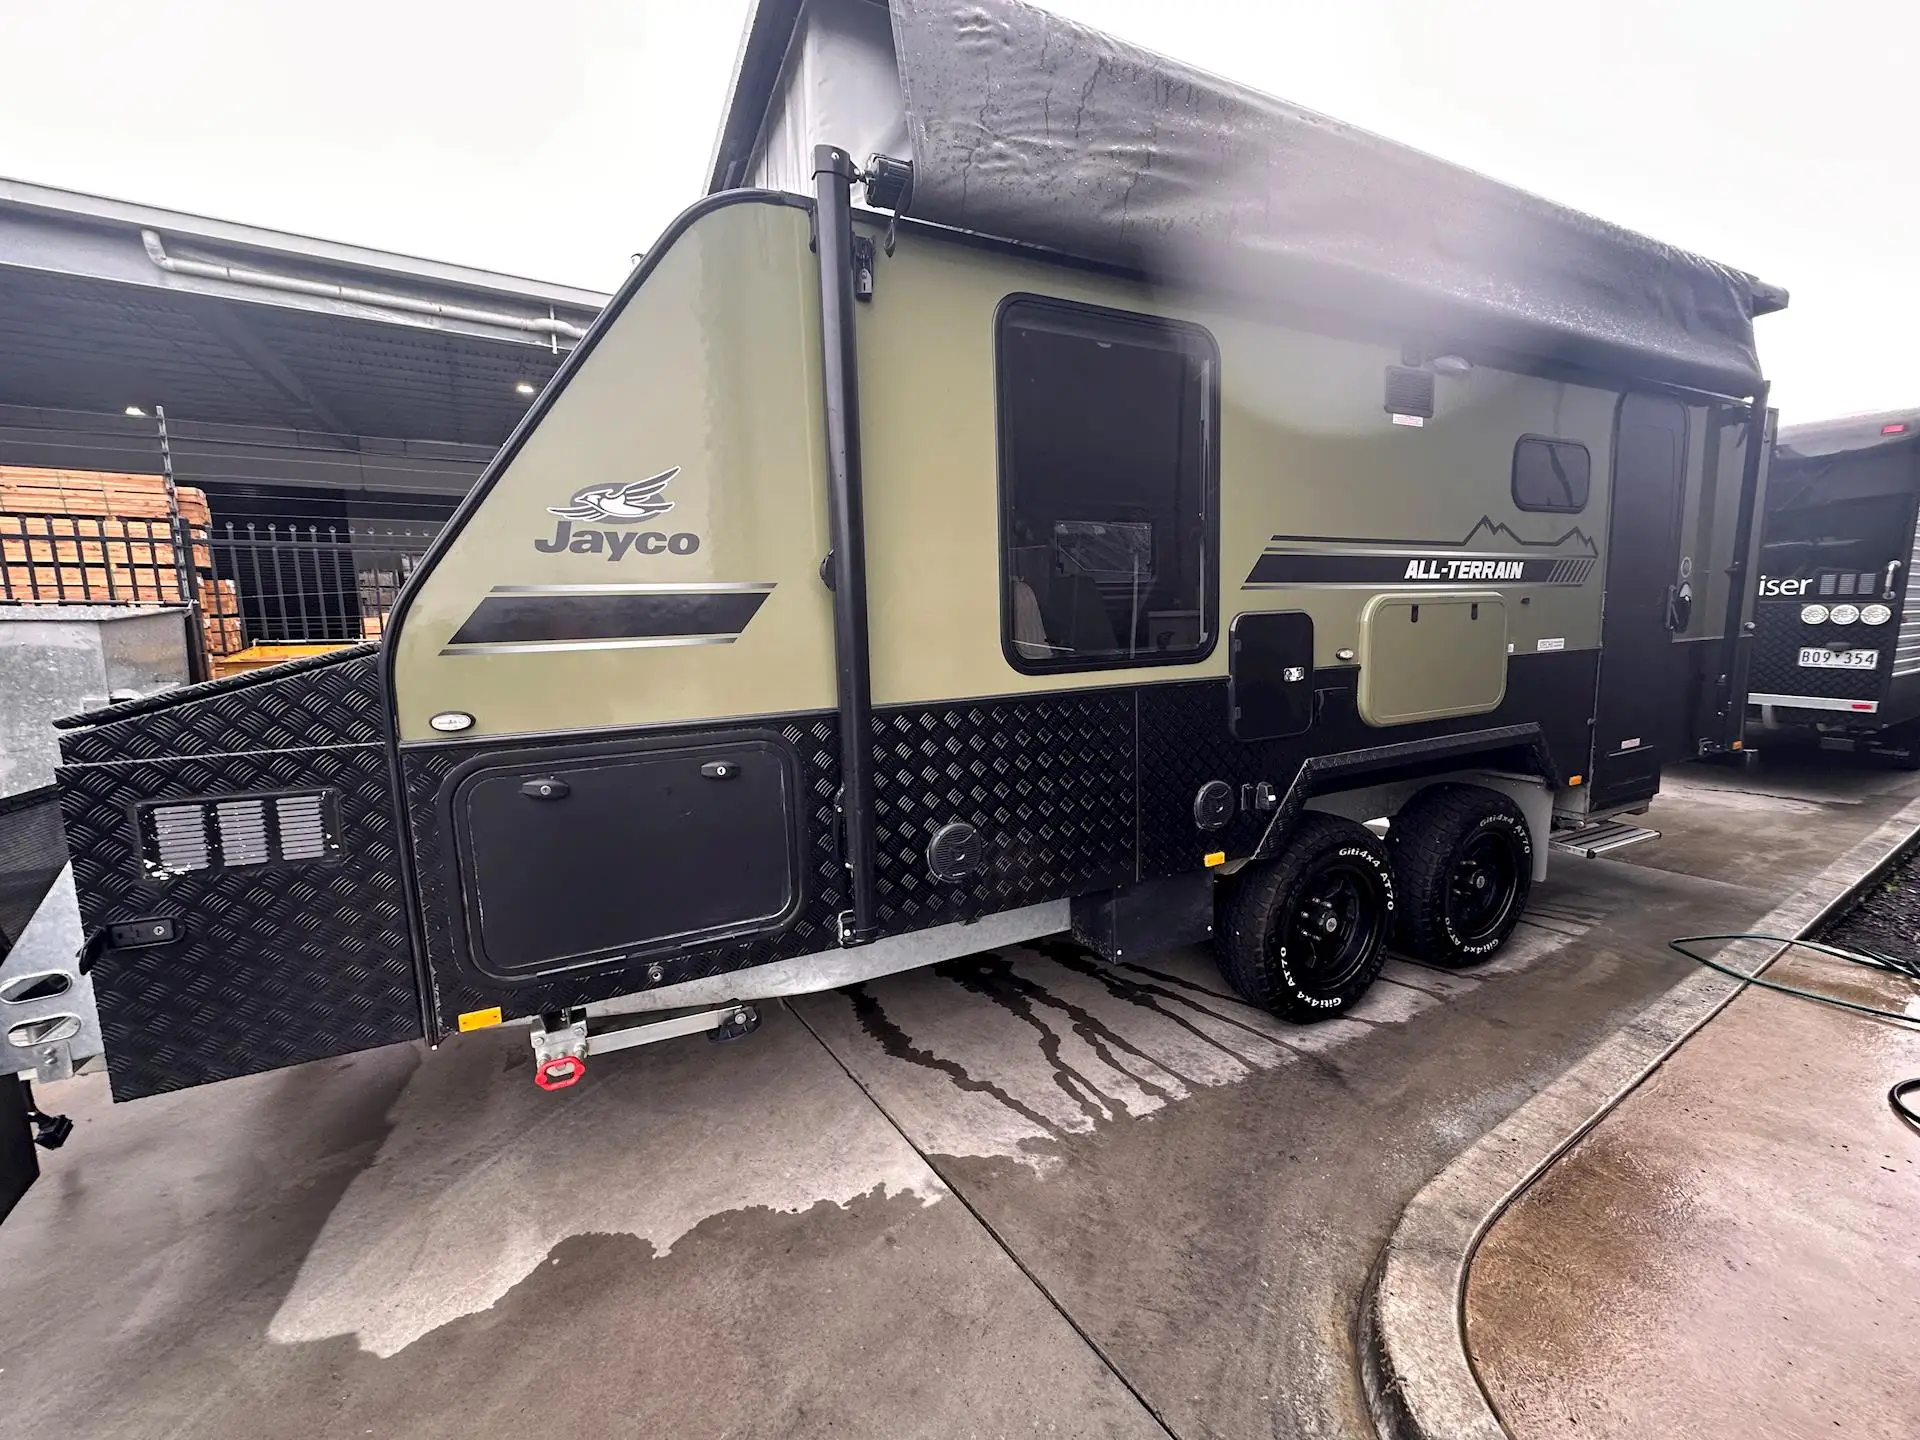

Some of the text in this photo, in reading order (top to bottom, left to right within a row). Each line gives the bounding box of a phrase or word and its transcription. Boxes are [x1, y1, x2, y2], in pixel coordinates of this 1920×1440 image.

[534, 520, 700, 562] Jayco
[1403, 559, 1525, 580] ALL-TERRAIN
[1843, 652, 1875, 665] 354
[1479, 814, 1530, 854] Giti4x4 AT70
[1339, 848, 1394, 910] Giti4x4 AT70
[1463, 939, 1499, 954] Giti4x4
[1280, 947, 1342, 1008] Giti4x4 AT70
